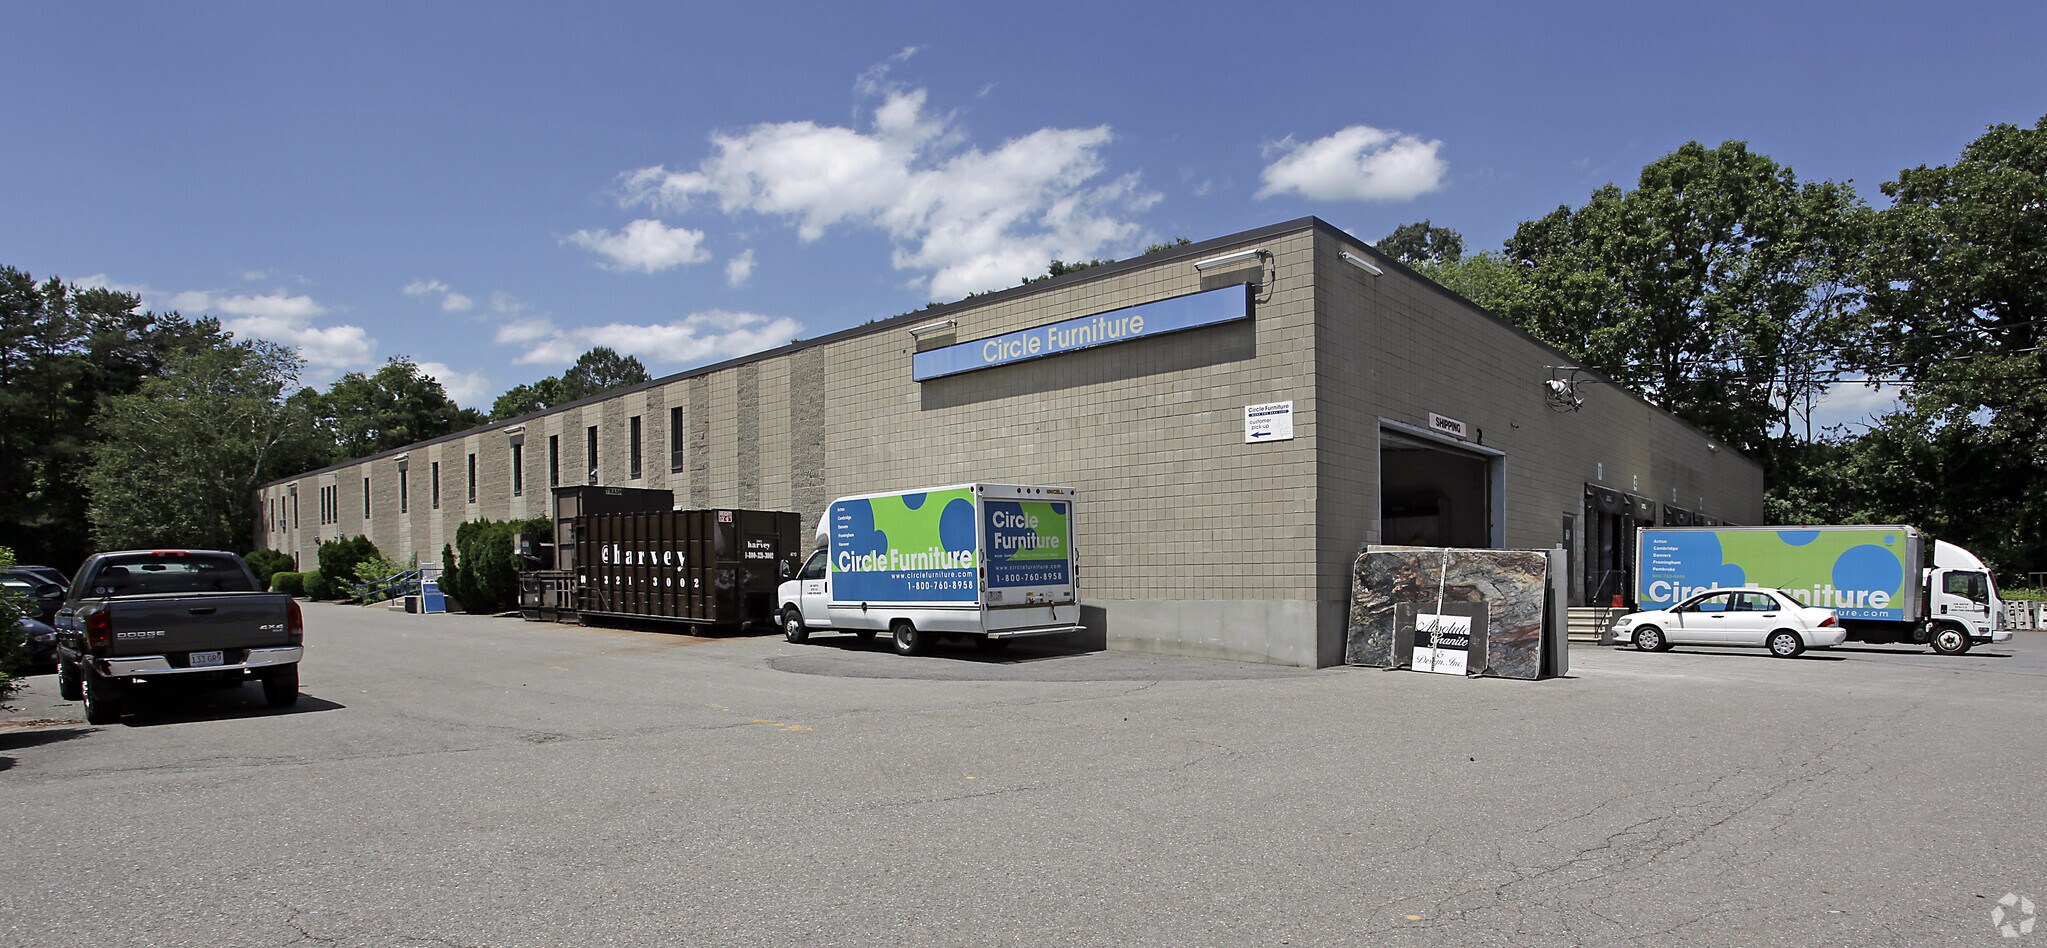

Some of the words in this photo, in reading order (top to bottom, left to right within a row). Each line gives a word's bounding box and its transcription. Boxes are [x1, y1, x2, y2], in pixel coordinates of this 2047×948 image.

[983, 333, 1041, 363] Circle
[1048, 315, 1144, 351] Furniture
[1436, 416, 1460, 433] SHIPPING
[992, 510, 1039, 529] Circle
[994, 532, 1060, 550] Furniture
[838, 550, 888, 573] Circle
[890, 546, 973, 571] Furniture
[891, 571, 973, 579] www.circlefurniture.com
[996, 572, 1063, 583] 1-800-760-8958
[907, 580, 974, 590] 1-800-760-8958
[1414, 654, 1445, 667] Desgn,
